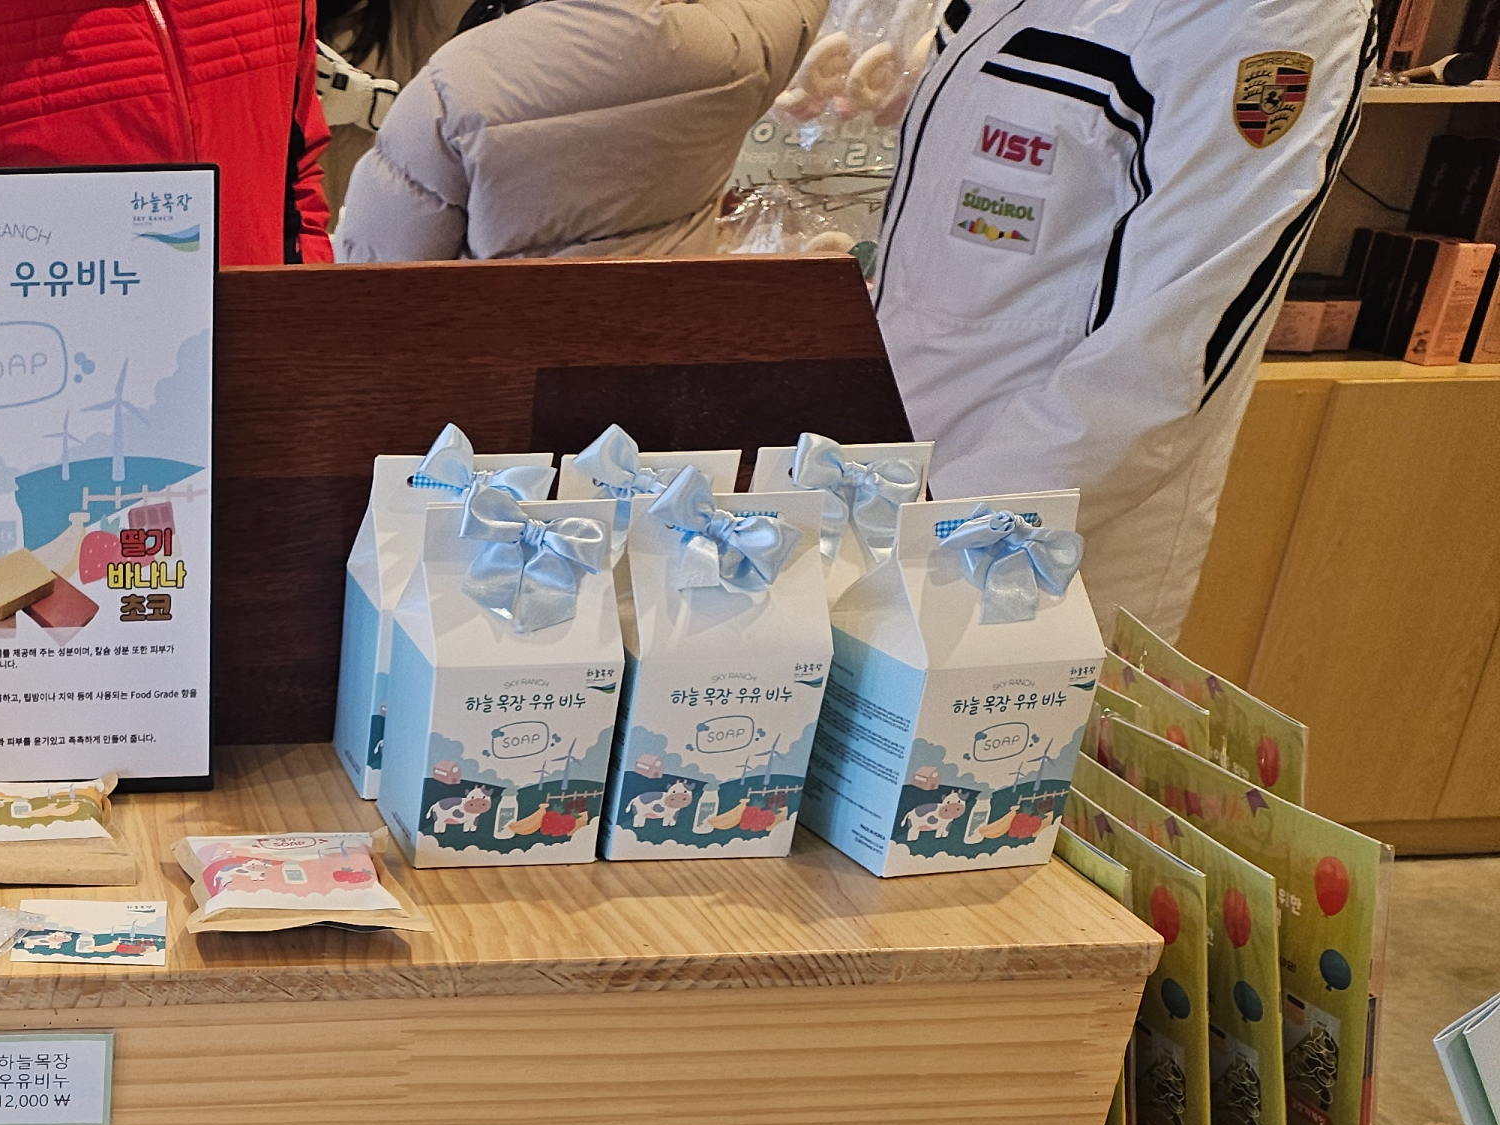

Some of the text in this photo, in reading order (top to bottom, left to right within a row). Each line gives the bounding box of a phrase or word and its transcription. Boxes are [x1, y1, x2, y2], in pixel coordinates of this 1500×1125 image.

[10, 260, 140, 297] 우유비누
[120, 528, 173, 557] 딸기
[107, 561, 187, 590] 바나나
[119, 594, 173, 622] 초코
[131, 690, 178, 699] Food Grade
[465, 693, 585, 713] 하늘 목장 우유 비누
[671, 687, 792, 706] 하늘 목장 우유 비누
[953, 691, 1066, 715] 하늘 목장 우유 비누
[501, 732, 540, 748] SOAP
[705, 726, 745, 743] SOAP
[982, 733, 1022, 752] SOAP
